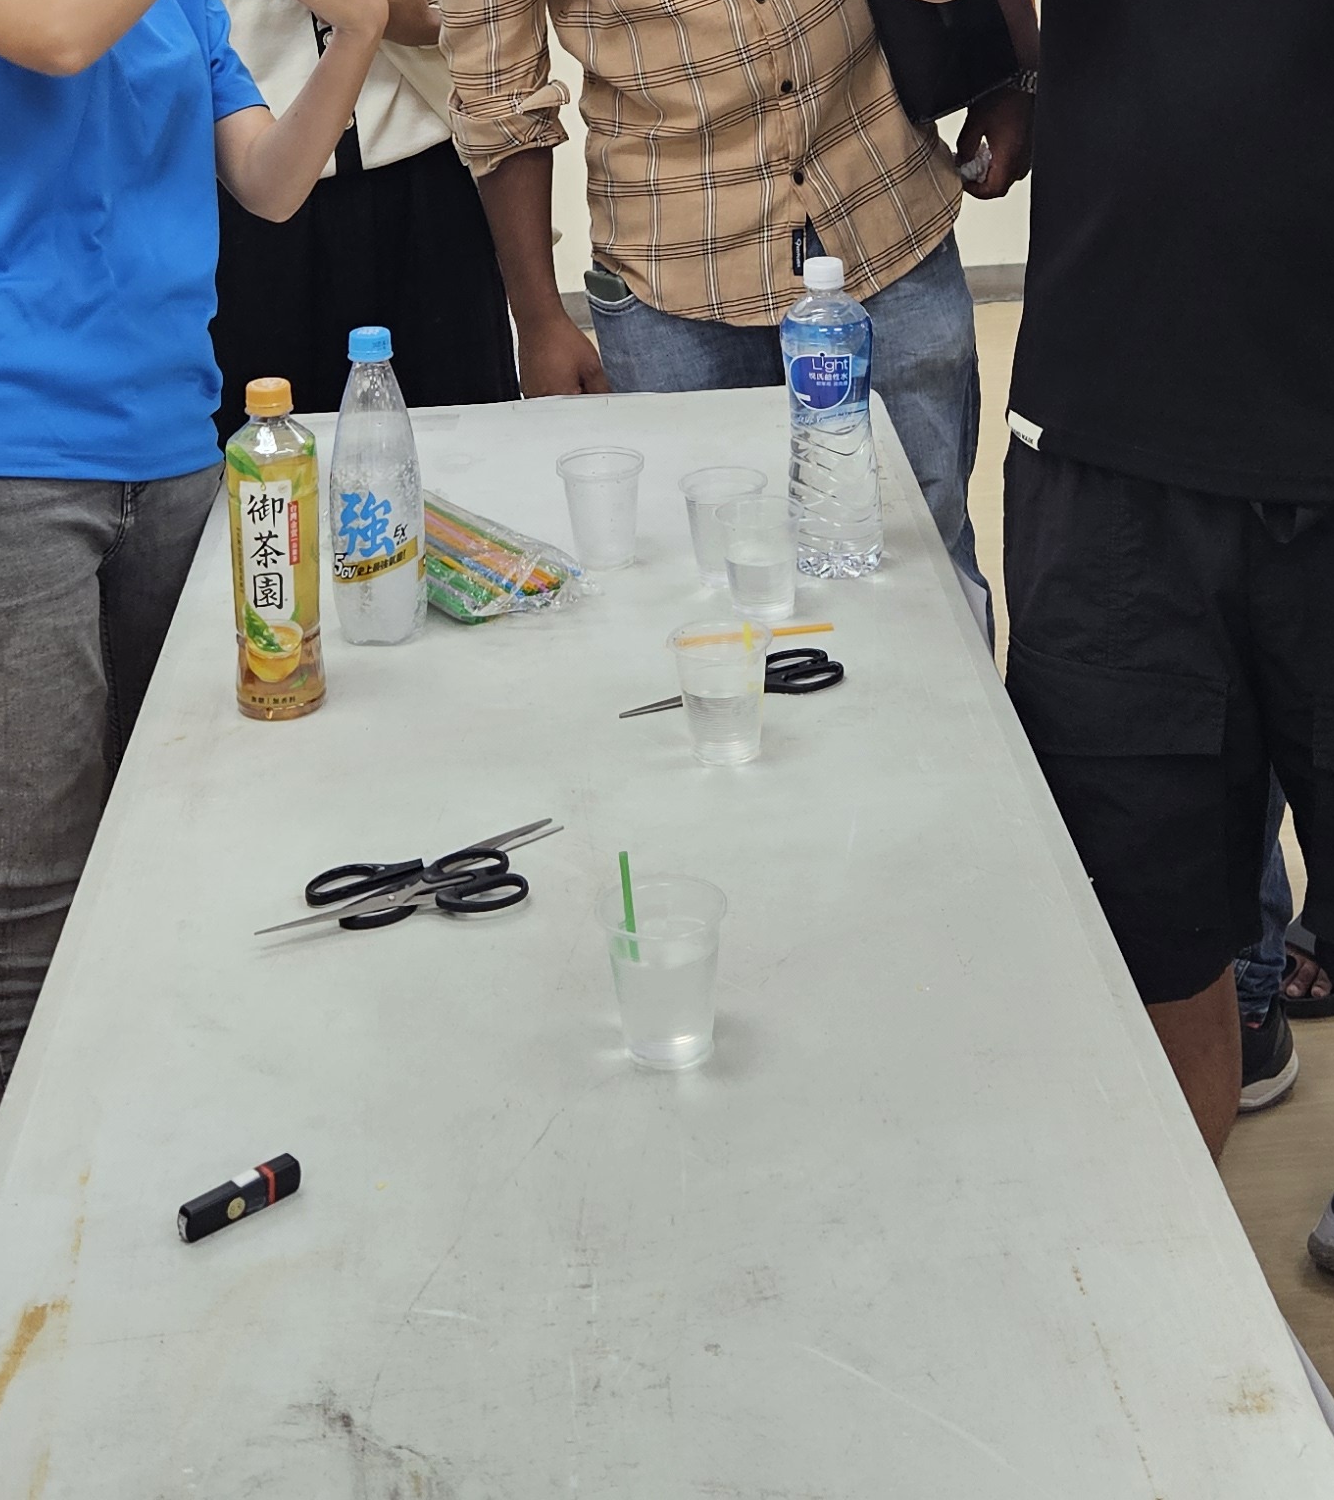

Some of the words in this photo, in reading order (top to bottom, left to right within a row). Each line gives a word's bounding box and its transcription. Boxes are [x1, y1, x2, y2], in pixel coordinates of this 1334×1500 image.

[811, 352, 849, 373] Light
[247, 494, 286, 610] 御茶園
[338, 491, 395, 558] 強
